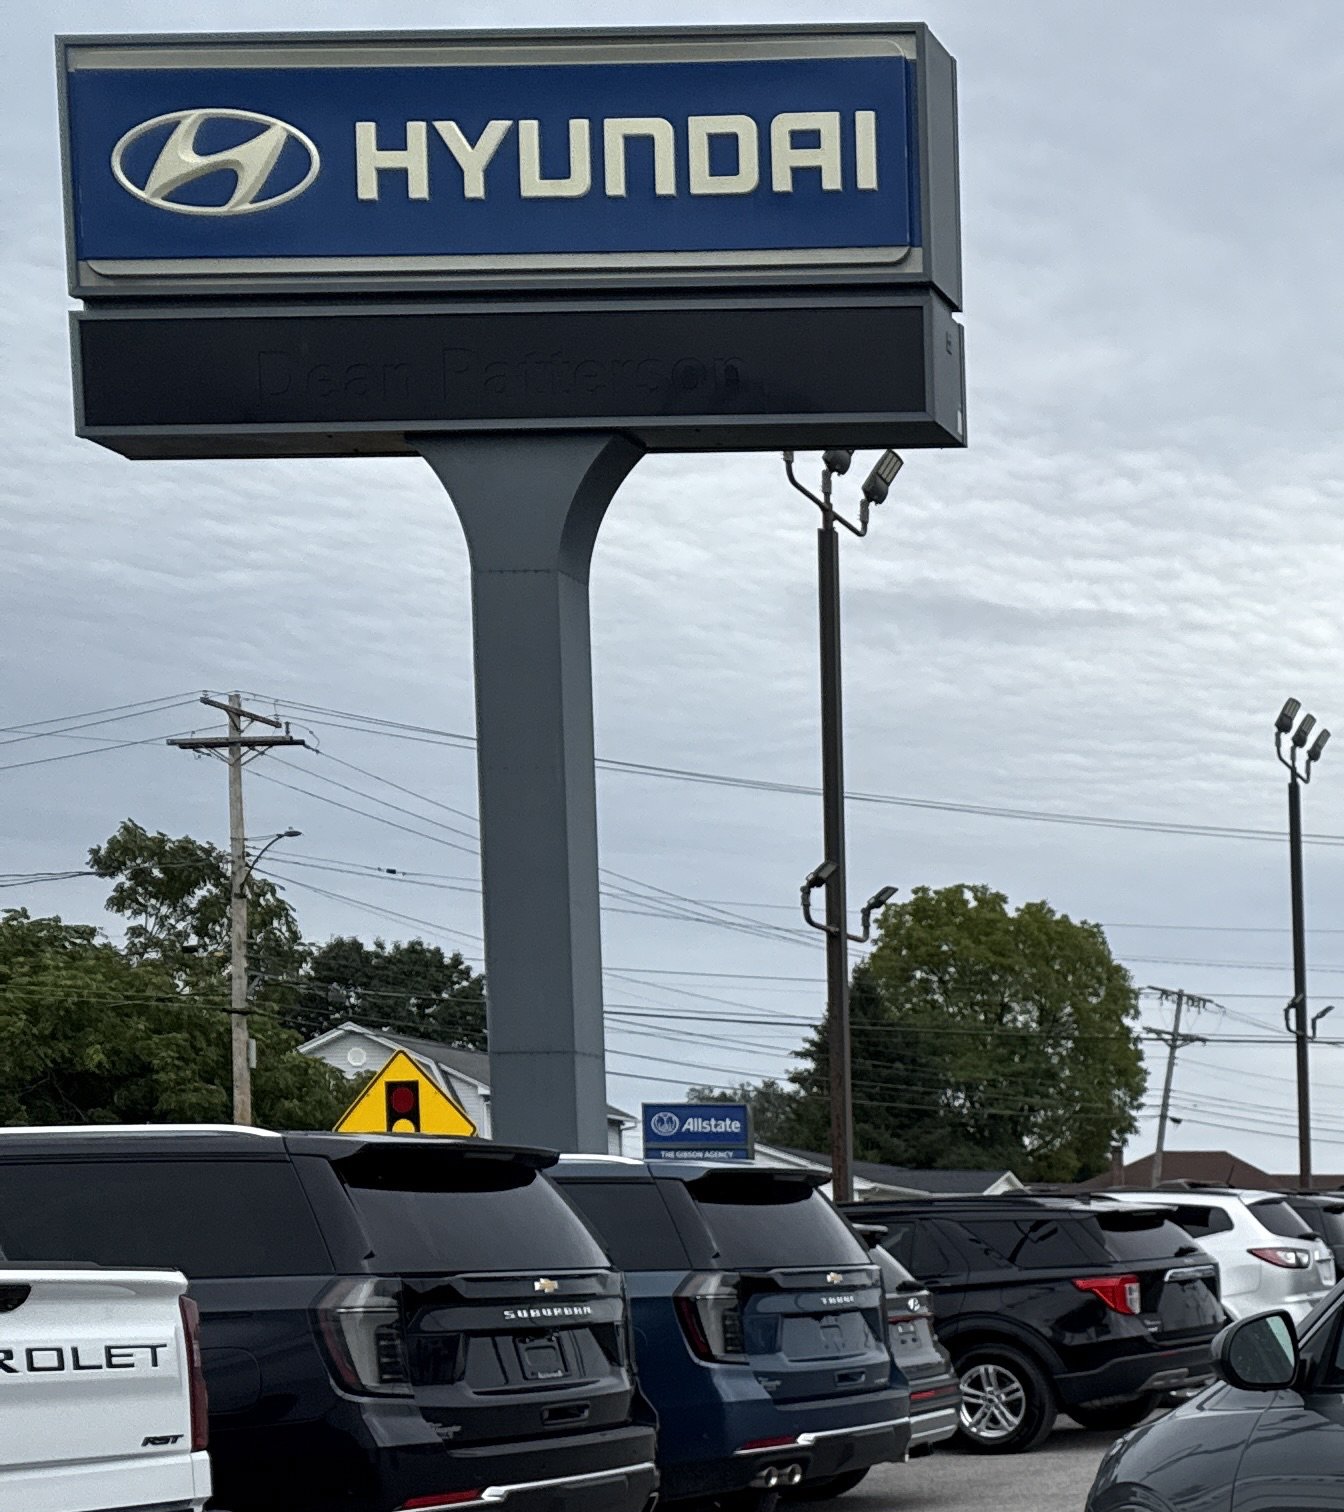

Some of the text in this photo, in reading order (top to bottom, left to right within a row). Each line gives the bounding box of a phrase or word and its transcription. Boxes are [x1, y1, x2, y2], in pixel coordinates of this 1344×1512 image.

[354, 109, 880, 201] HYUNDAI
[681, 1117, 741, 1133] Allstate
[503, 1306, 592, 1320] SUBURBAN
[0, 1343, 167, 1374] ROLET
